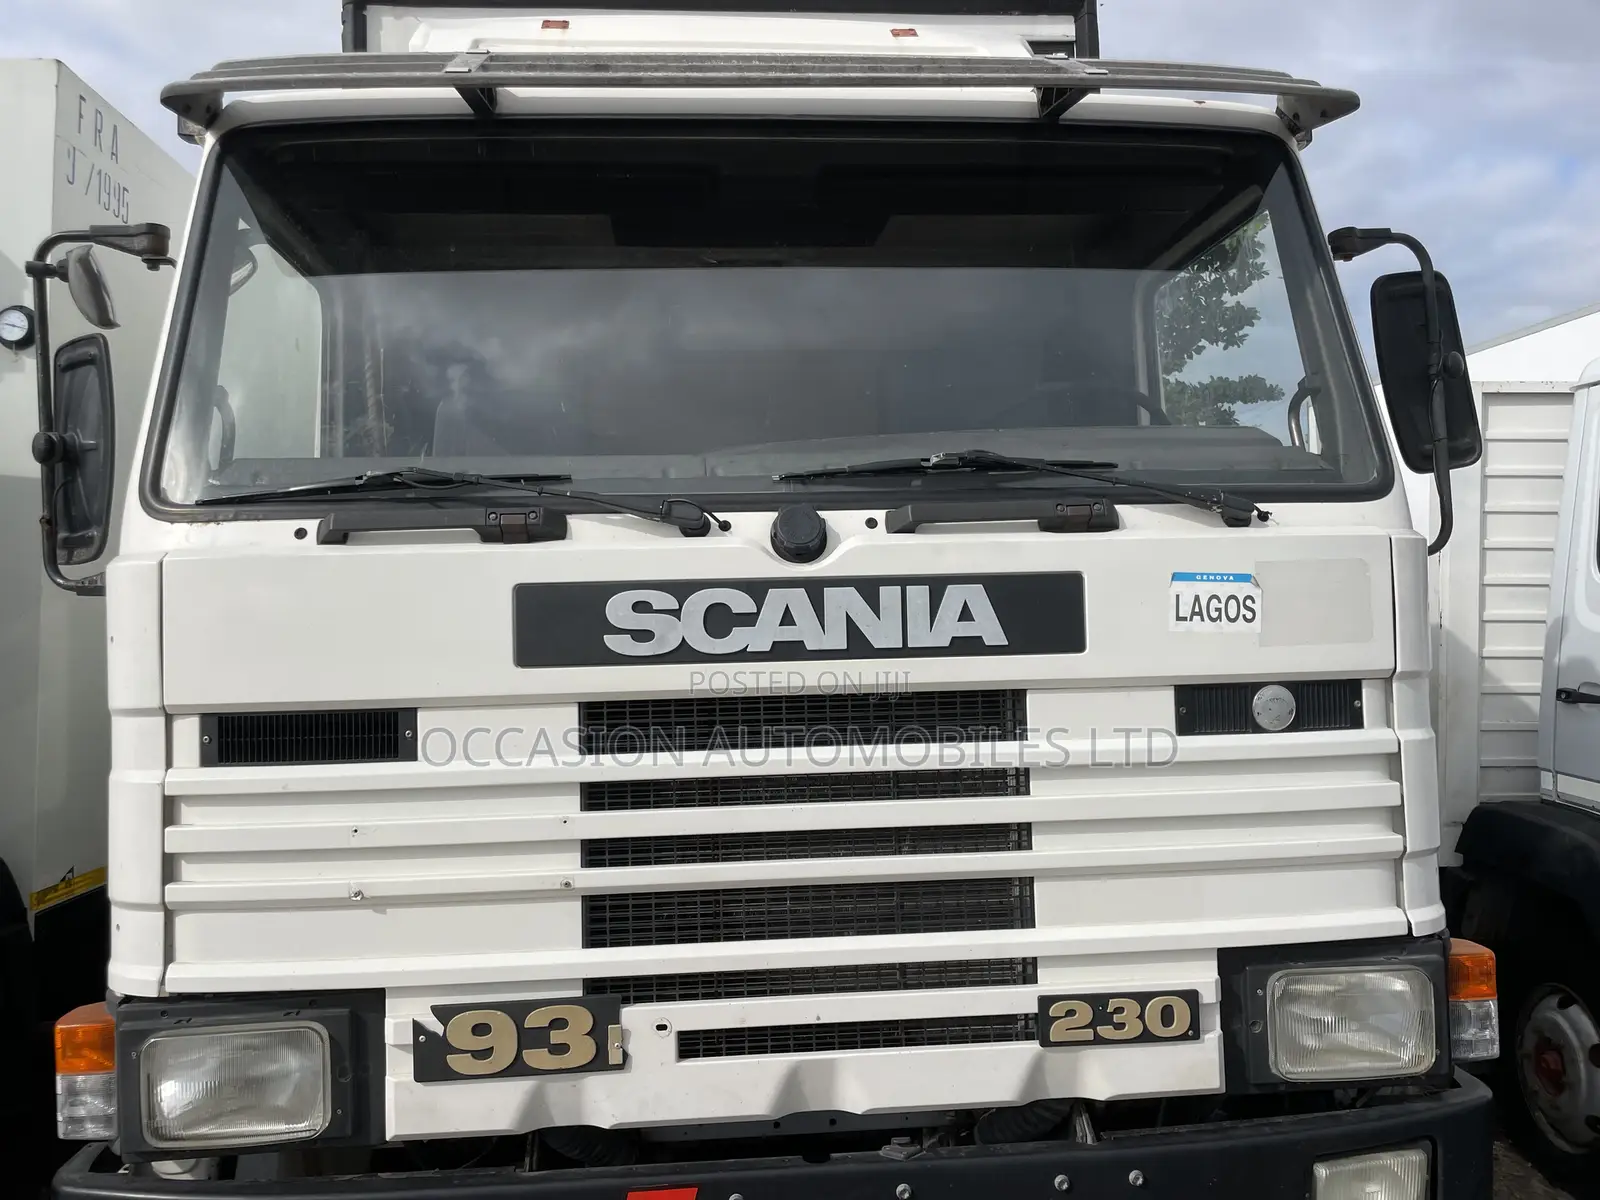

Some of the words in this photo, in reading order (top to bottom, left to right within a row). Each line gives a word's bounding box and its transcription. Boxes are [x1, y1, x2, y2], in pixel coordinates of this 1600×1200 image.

[603, 583, 1009, 656] SCANIA
[1175, 594, 1257, 623] LAGOS
[1049, 996, 1191, 1042] 230
